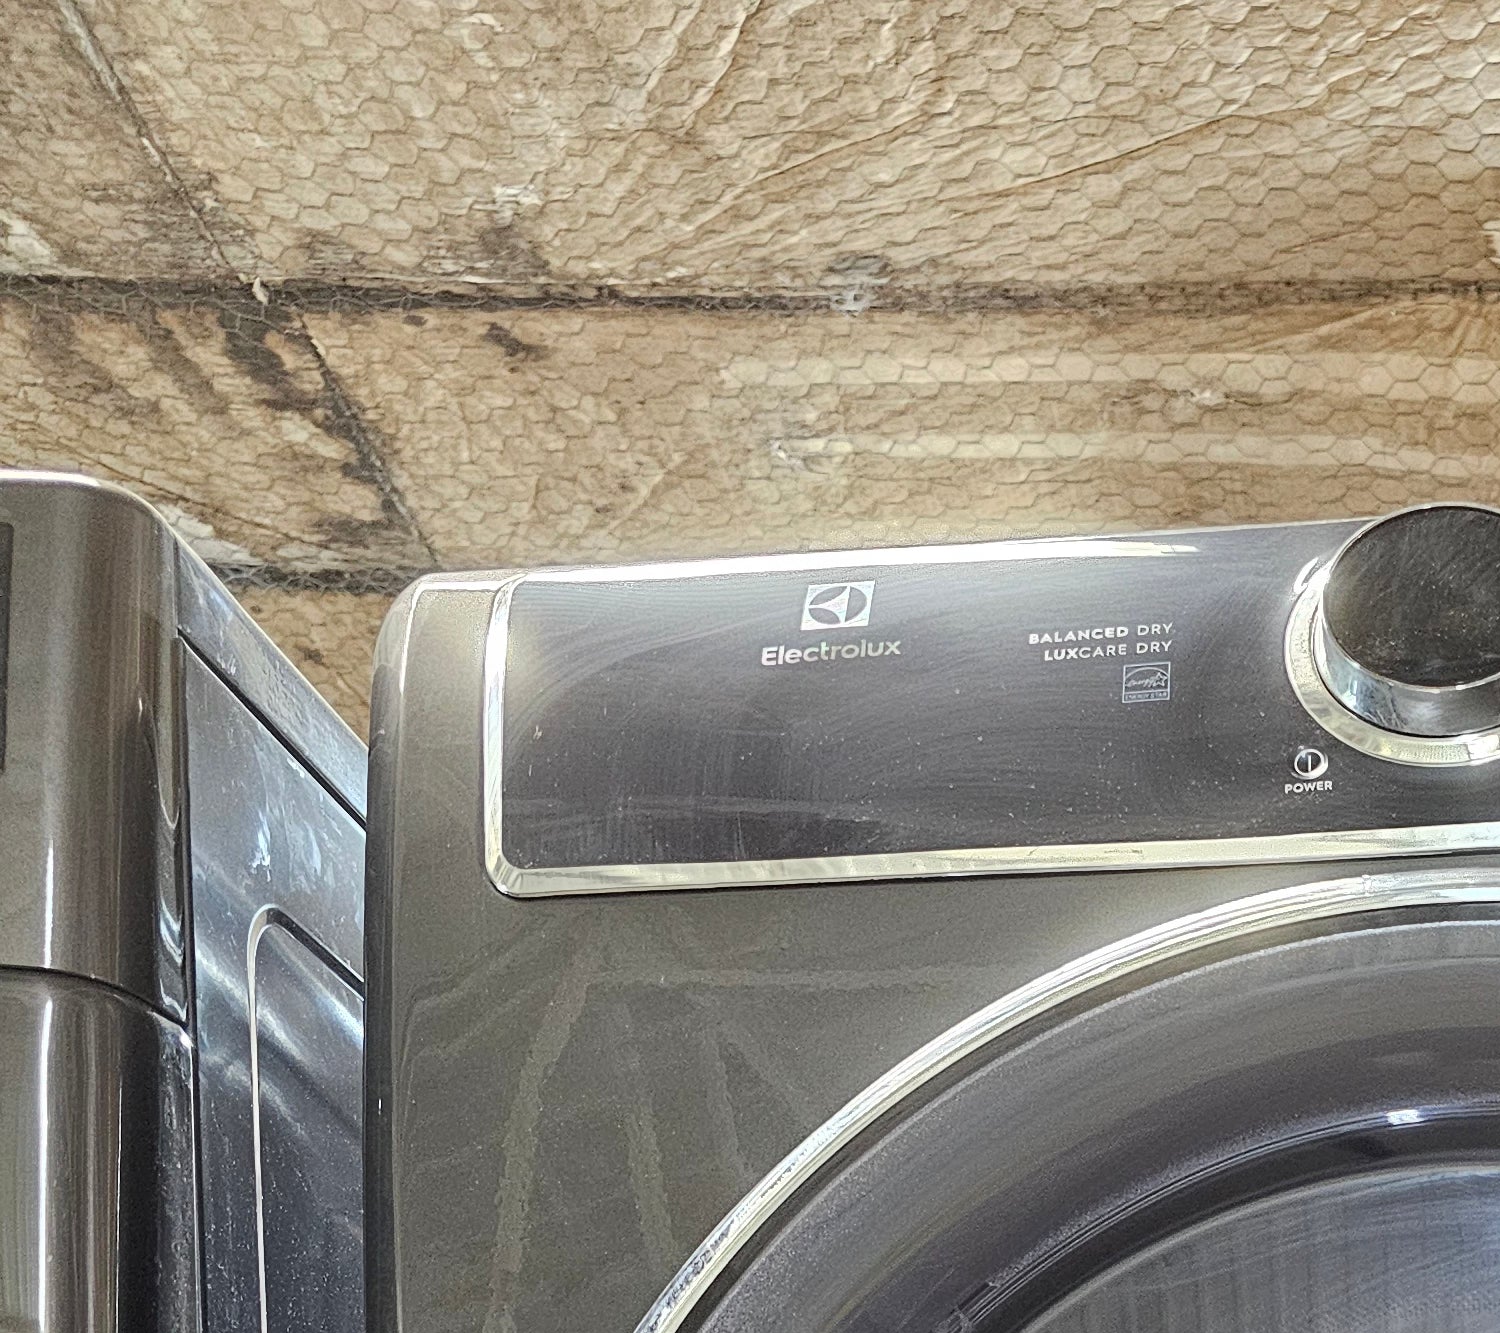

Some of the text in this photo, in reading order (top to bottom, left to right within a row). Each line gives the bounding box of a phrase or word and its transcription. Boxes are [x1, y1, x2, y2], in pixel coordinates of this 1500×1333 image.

[1028, 621, 1174, 645] BALANCED DRY
[761, 639, 901, 666] Electrolux
[1044, 640, 1173, 661] LUXCARE DRY
[1284, 780, 1333, 794] POWER
